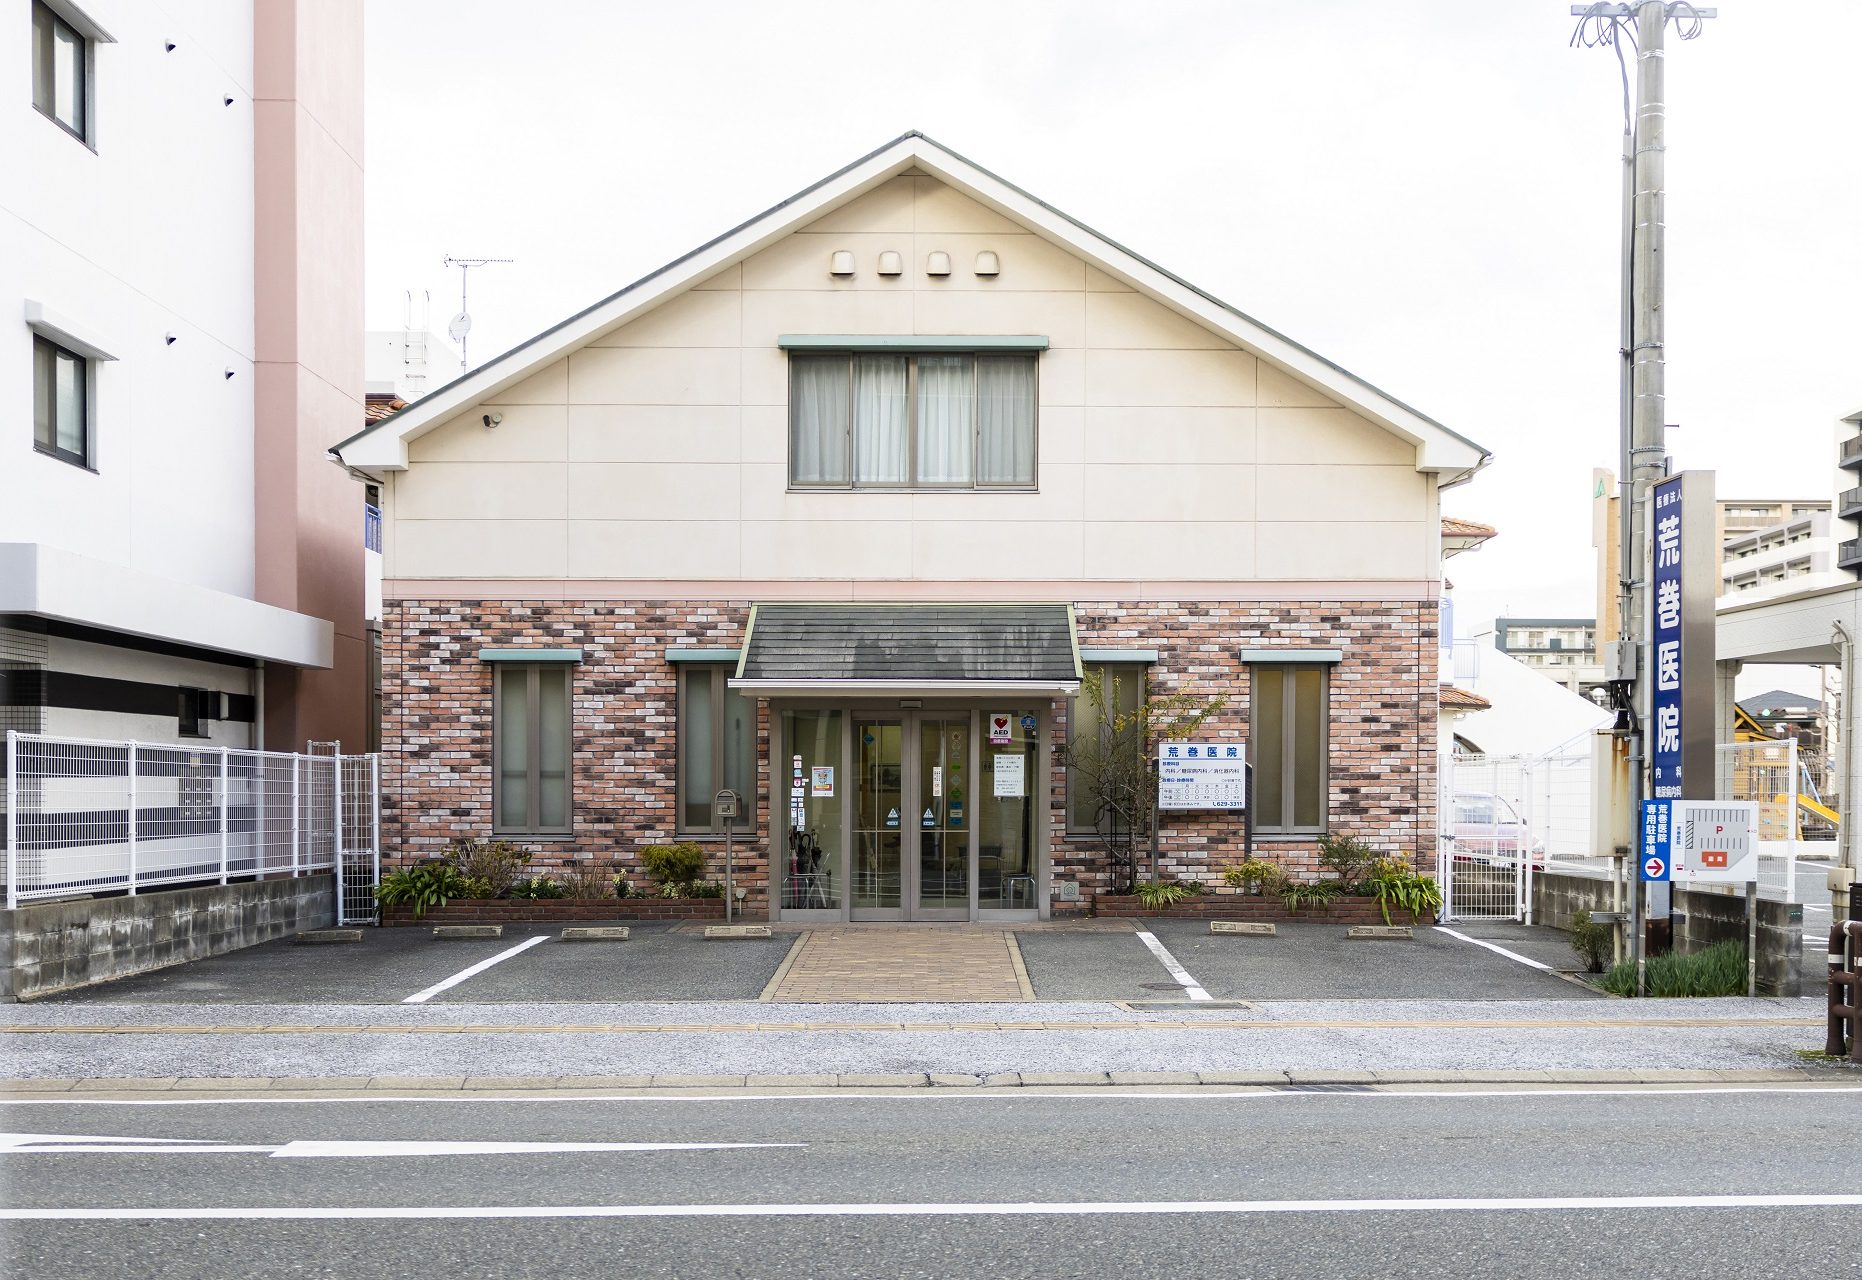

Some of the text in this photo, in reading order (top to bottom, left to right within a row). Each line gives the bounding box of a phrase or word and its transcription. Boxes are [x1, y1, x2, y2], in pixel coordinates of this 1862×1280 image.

[1656, 488, 1682, 509] 医療法人
[1658, 514, 1680, 753] 荒巻医院
[1168, 746, 1237, 758] 荒巻医院
[1655, 766, 1682, 779] 内科
[1655, 786, 1682, 798] 糖尿病内科
[1645, 804, 1657, 855] 専用駐車場
[1657, 804, 1668, 843] 荒巻医院
[1716, 825, 1724, 834] P
